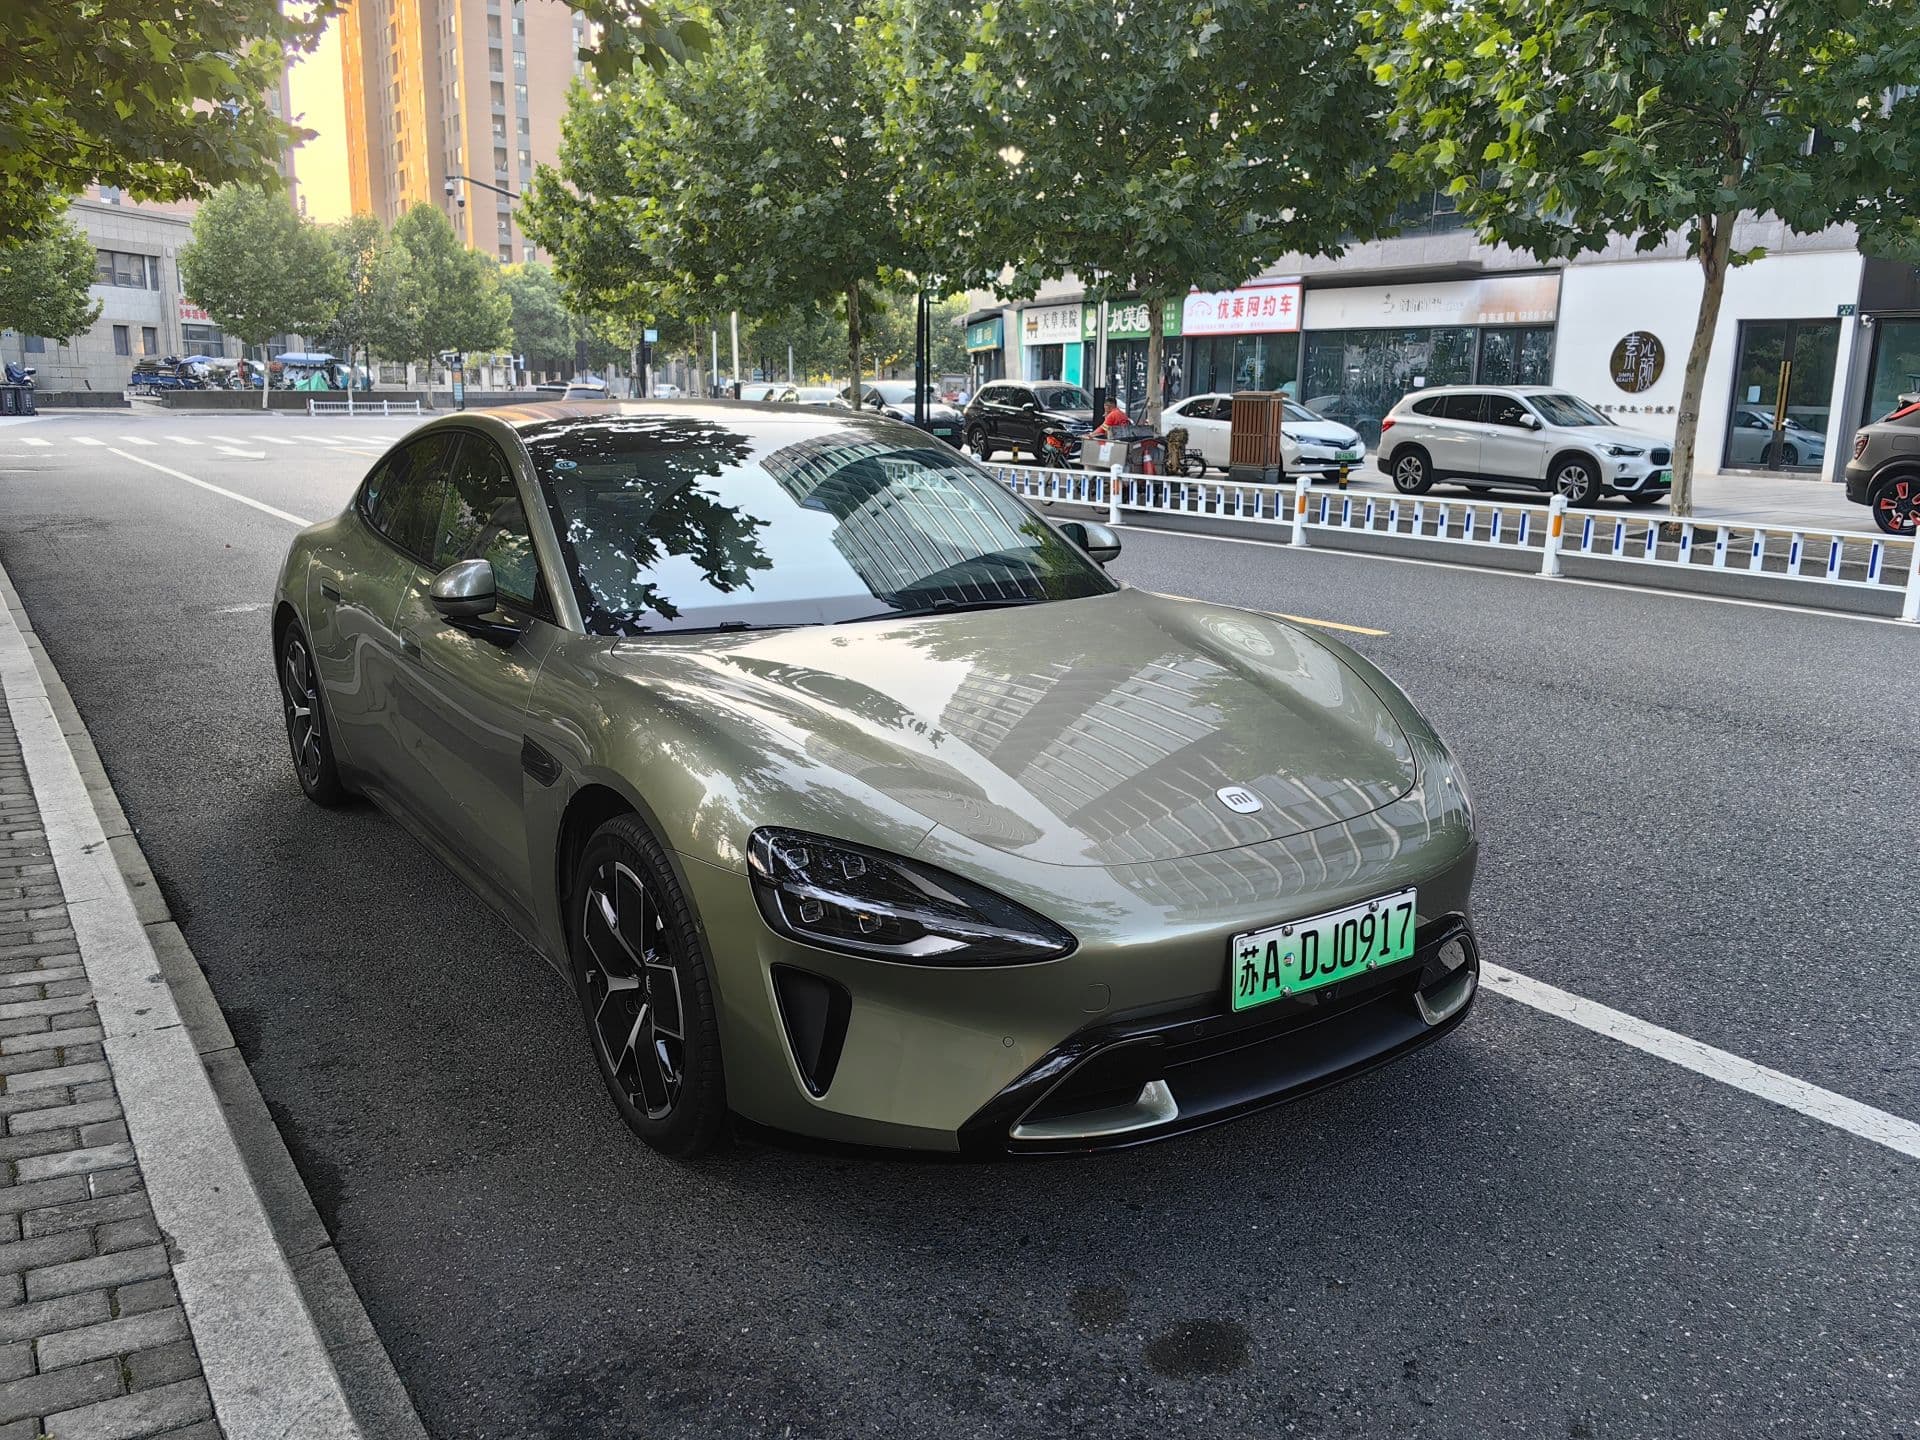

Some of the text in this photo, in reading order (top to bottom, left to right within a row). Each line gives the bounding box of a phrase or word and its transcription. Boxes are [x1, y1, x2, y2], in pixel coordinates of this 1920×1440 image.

[1217, 295, 1293, 319] 优乘网约车
[1299, 902, 1412, 981] DJ0917
